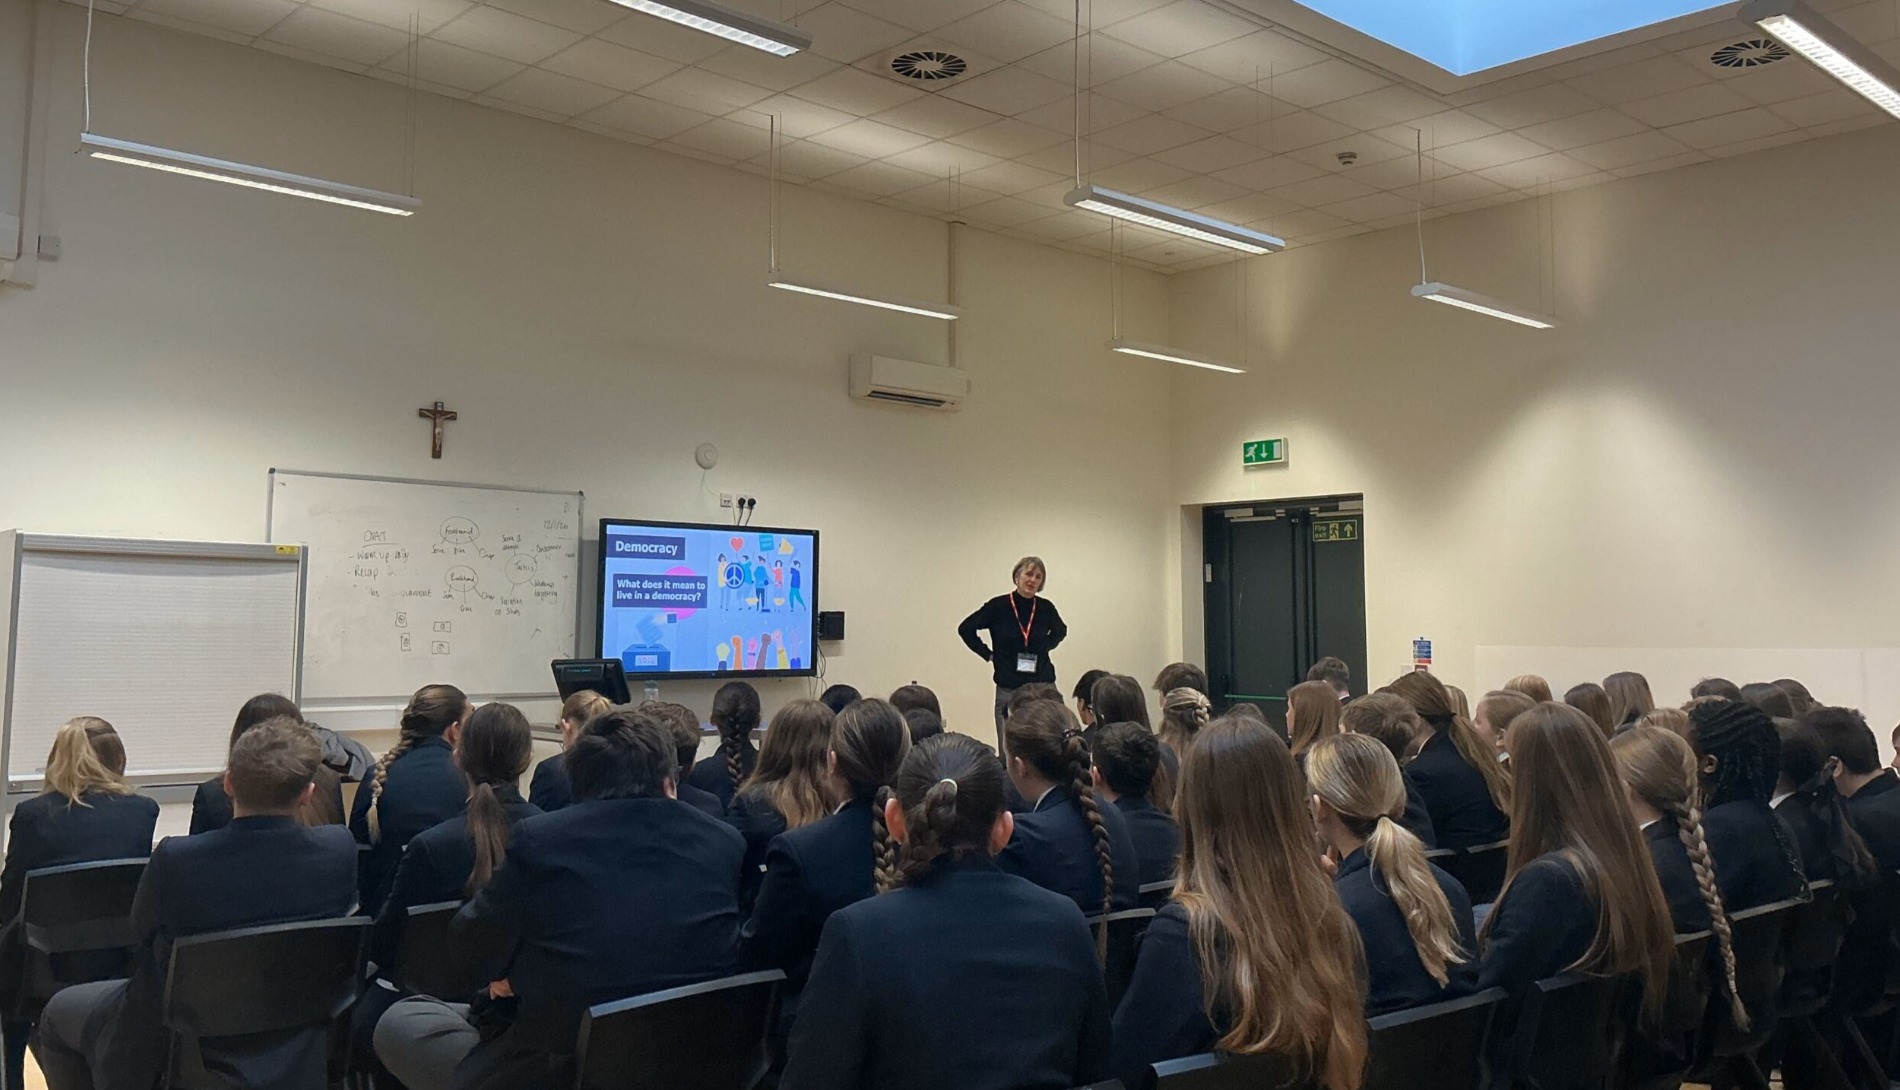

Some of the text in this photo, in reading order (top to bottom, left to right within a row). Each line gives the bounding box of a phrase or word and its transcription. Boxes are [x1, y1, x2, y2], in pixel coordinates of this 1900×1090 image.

[615, 540, 678, 556] Democracy
[617, 579, 706, 590] What does it mean to
[616, 590, 701, 602] live in a democracy?
